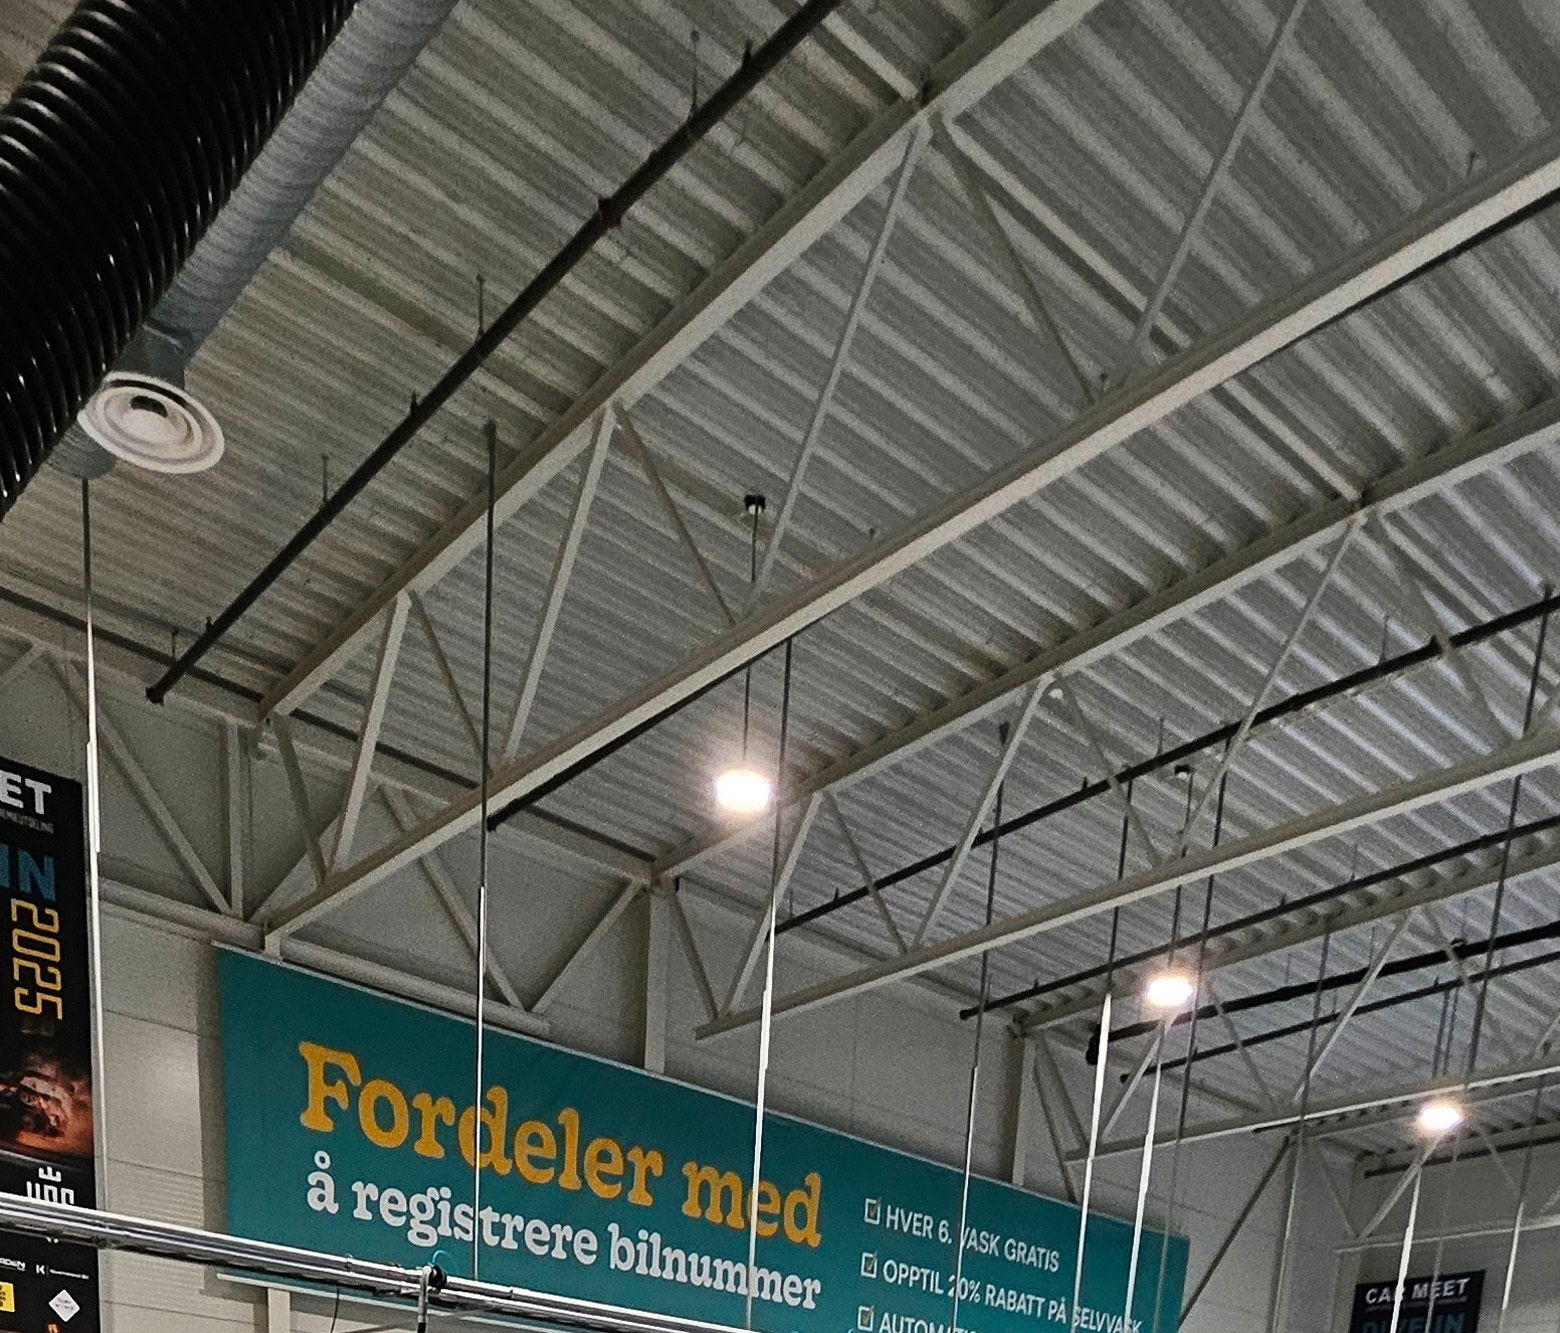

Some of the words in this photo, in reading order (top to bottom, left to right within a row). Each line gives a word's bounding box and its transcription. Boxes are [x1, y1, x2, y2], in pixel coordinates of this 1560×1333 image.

[11, 898, 63, 1021] 2025
[298, 1041, 664, 1207] Fordeler
[682, 1160, 822, 1248] med
[306, 1151, 339, 1214] å
[352, 1178, 600, 1265] registrere
[607, 1223, 822, 1310] bilnummer
[886, 1204, 934, 1240] HVER
[938, 1219, 953, 1245] 6.
[1003, 1238, 1060, 1272] GRATIS
[883, 1259, 945, 1295] OPPTIL
[984, 1283, 1046, 1318] RABATT
[1048, 1296, 1067, 1324] PÅ
[1411, 1277, 1471, 1300] MEET
